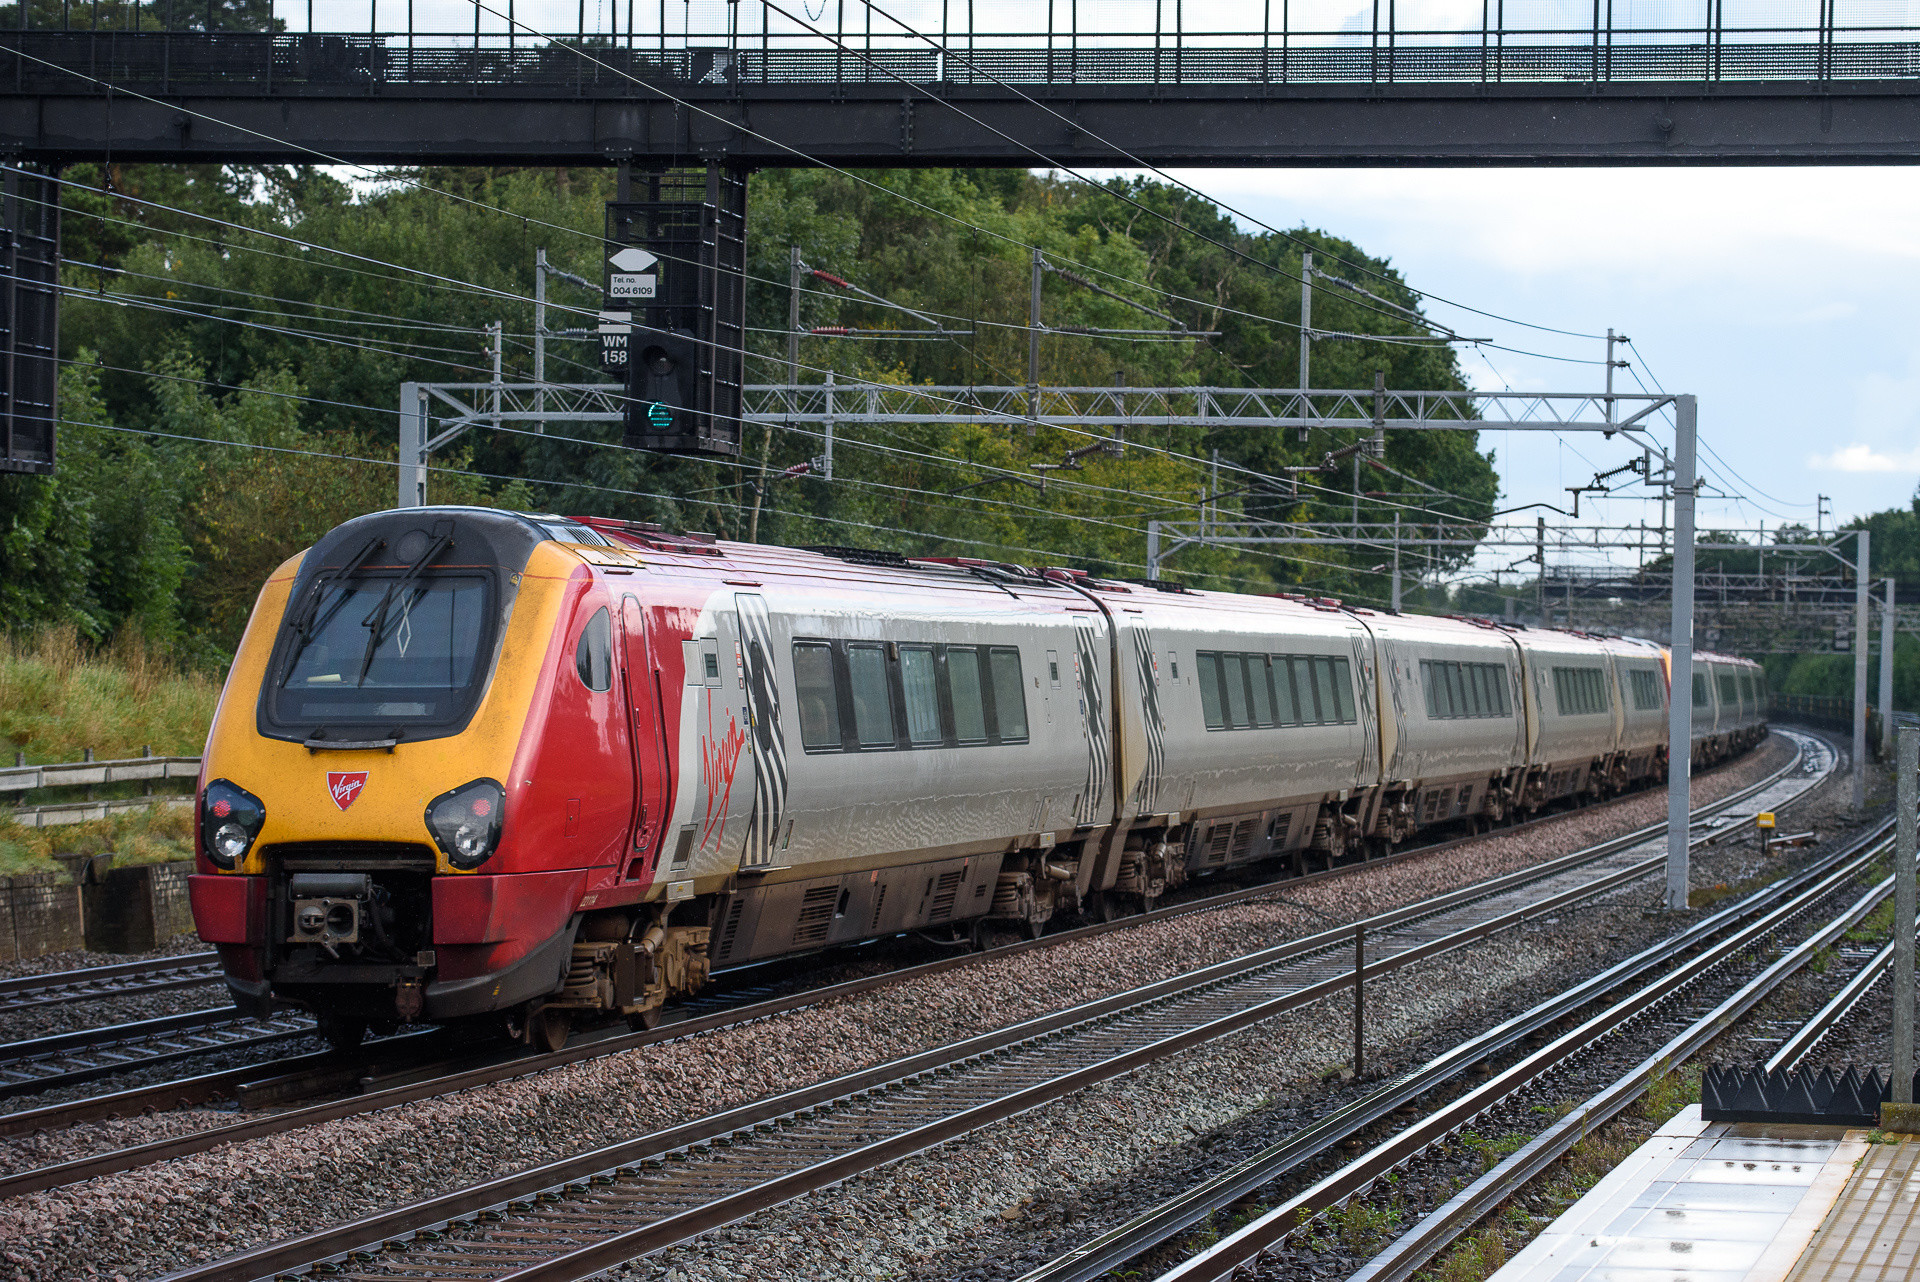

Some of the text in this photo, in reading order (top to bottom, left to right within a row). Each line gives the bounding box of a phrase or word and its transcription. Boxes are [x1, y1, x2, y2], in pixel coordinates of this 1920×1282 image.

[612, 286, 653, 295] 004 6109
[602, 335, 628, 348] WM
[602, 350, 628, 363] 158
[700, 688, 745, 853] Virgin
[332, 775, 362, 800] Virgin
